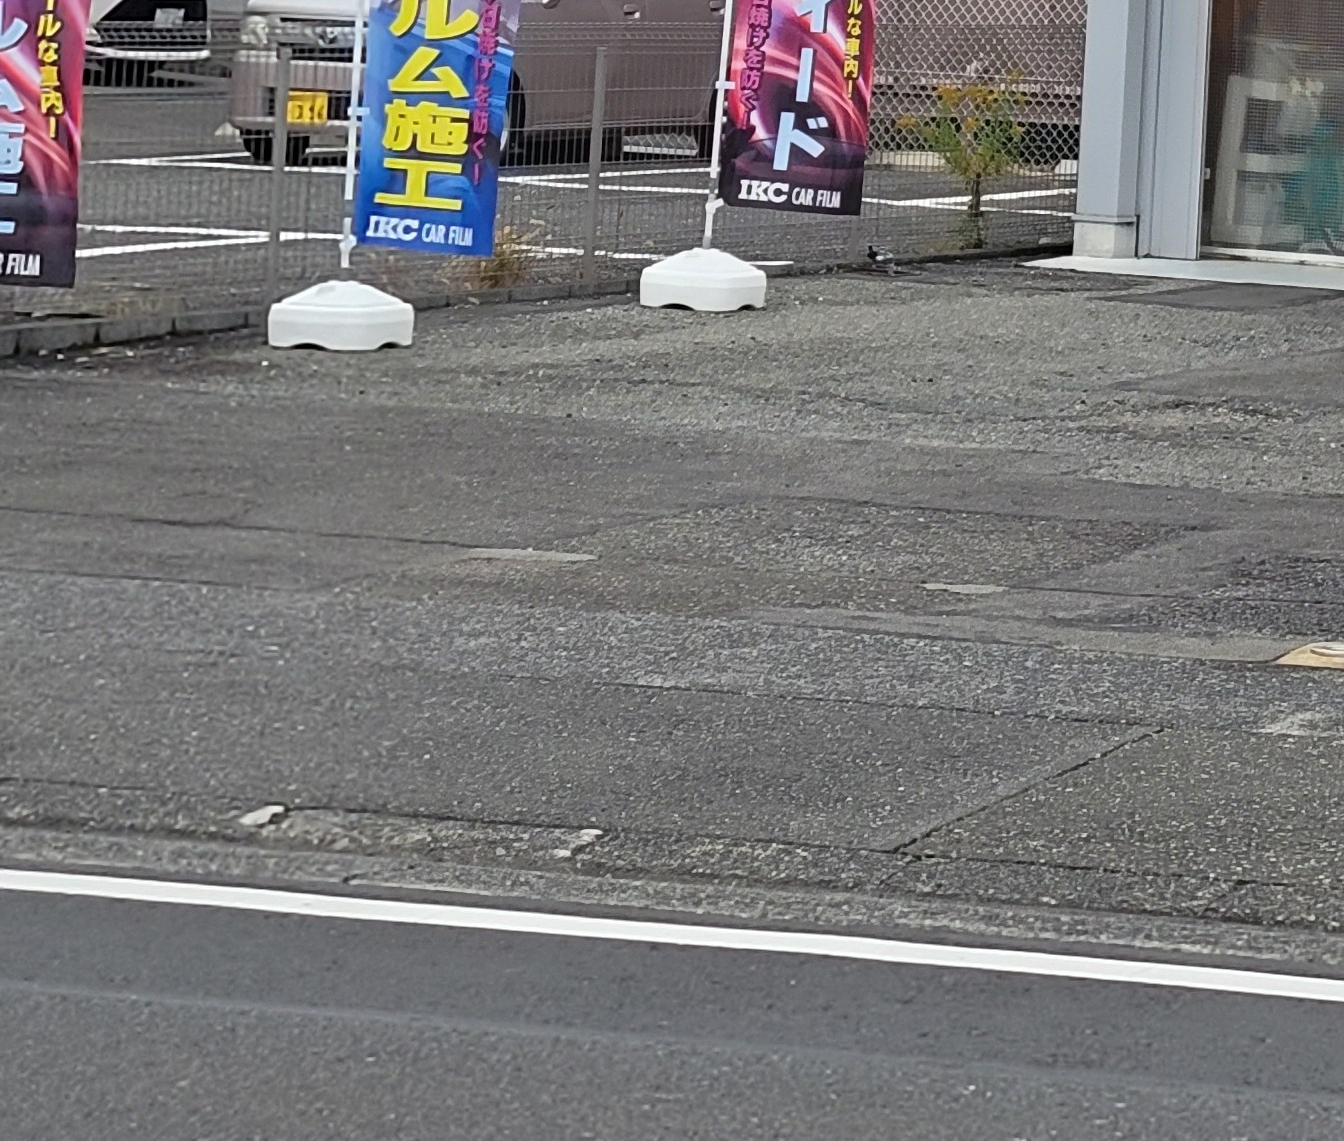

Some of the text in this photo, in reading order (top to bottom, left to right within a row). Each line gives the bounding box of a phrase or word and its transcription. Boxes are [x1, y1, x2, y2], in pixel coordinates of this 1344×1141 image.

[737, 179, 842, 209] IKC CAR FILM
[366, 215, 473, 247] IKC CAR FILM
